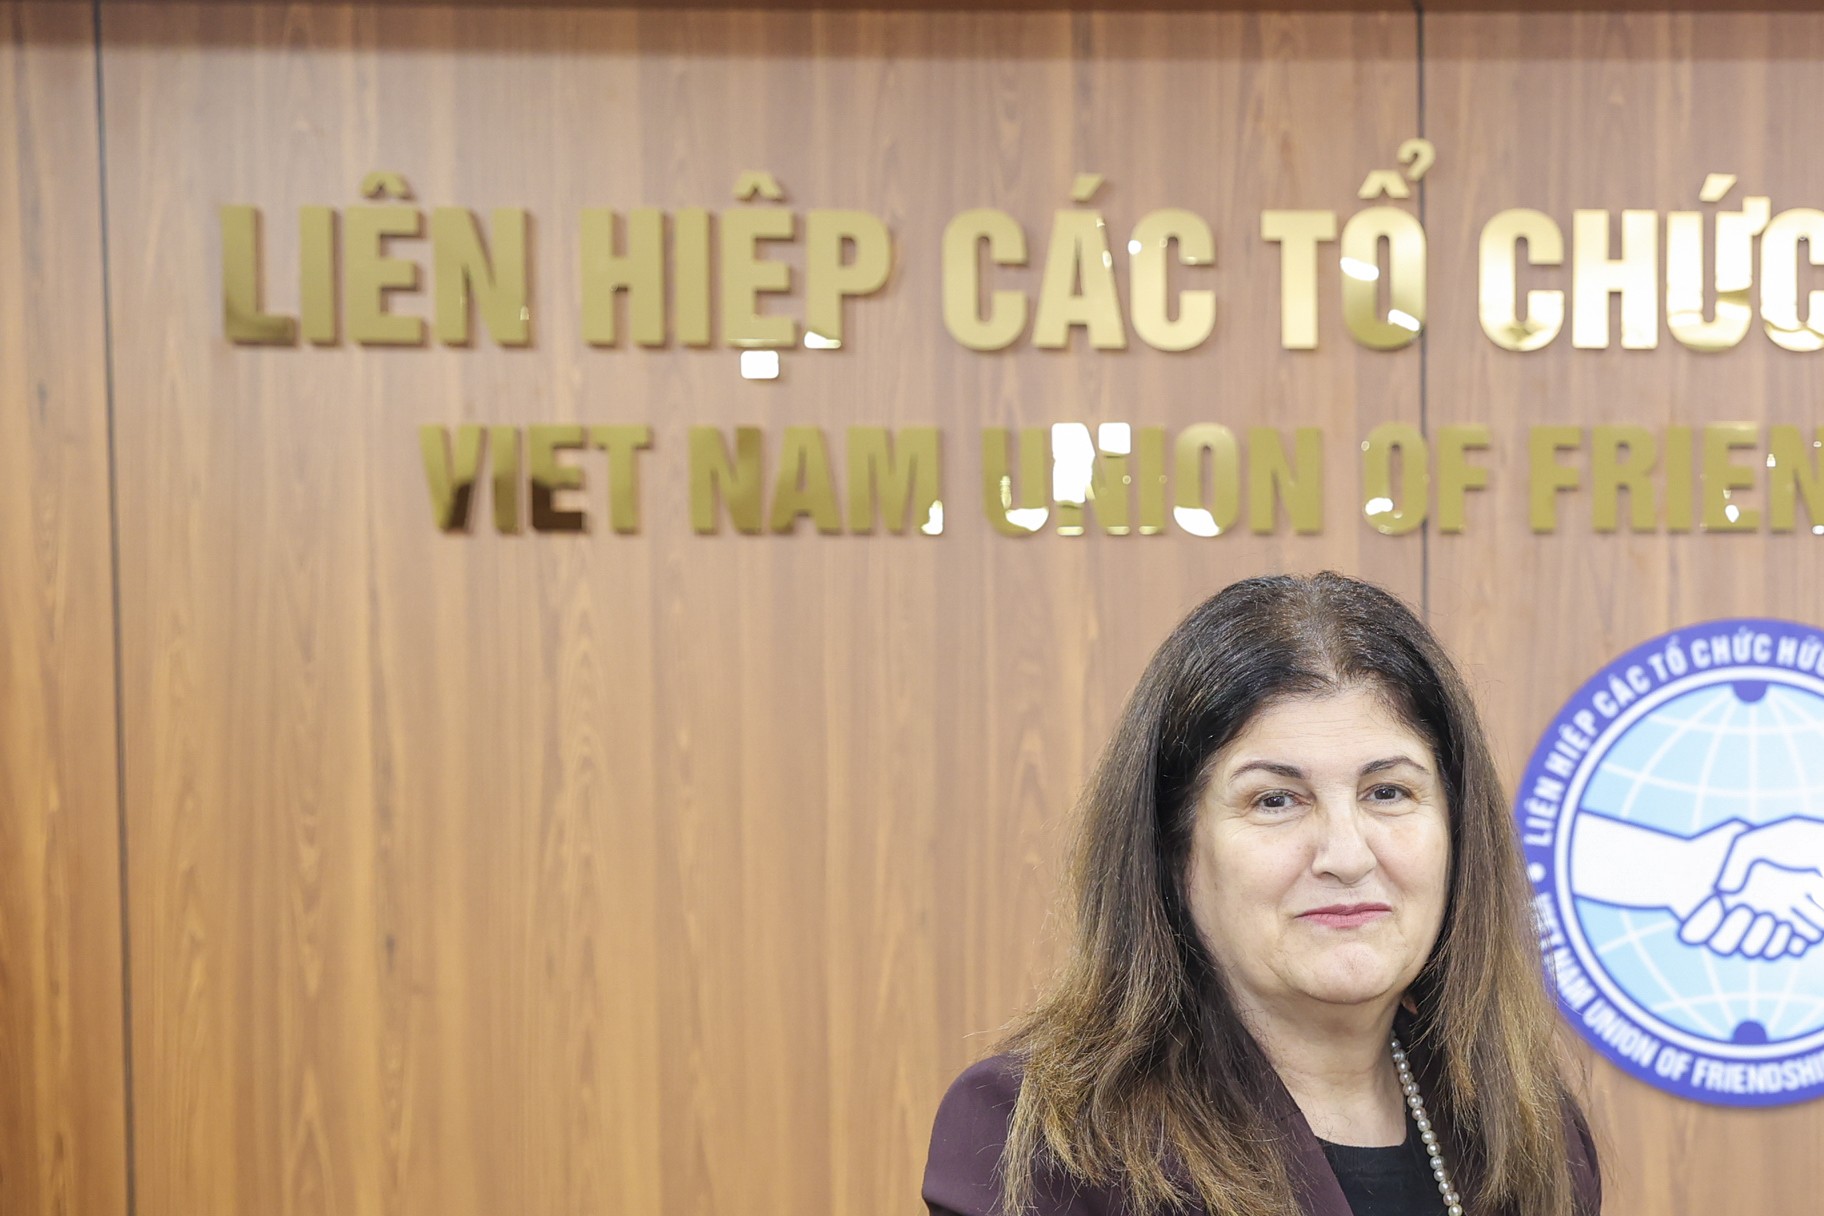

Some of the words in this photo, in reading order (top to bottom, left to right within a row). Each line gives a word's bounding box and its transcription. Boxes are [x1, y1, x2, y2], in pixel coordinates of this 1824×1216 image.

[219, 171, 532, 346] LIÊN
[580, 170, 892, 379] HIỆP
[940, 173, 1216, 352] CÁC
[1260, 138, 1436, 350] TỔ
[419, 424, 652, 535] VIET
[688, 424, 944, 536] NAM
[982, 421, 1322, 538] UNION
[1363, 421, 1491, 536] OF
[1523, 775, 1565, 847] LIÊN
[1582, 998, 1661, 1069] UNION
[1654, 1046, 1694, 1082] OF
